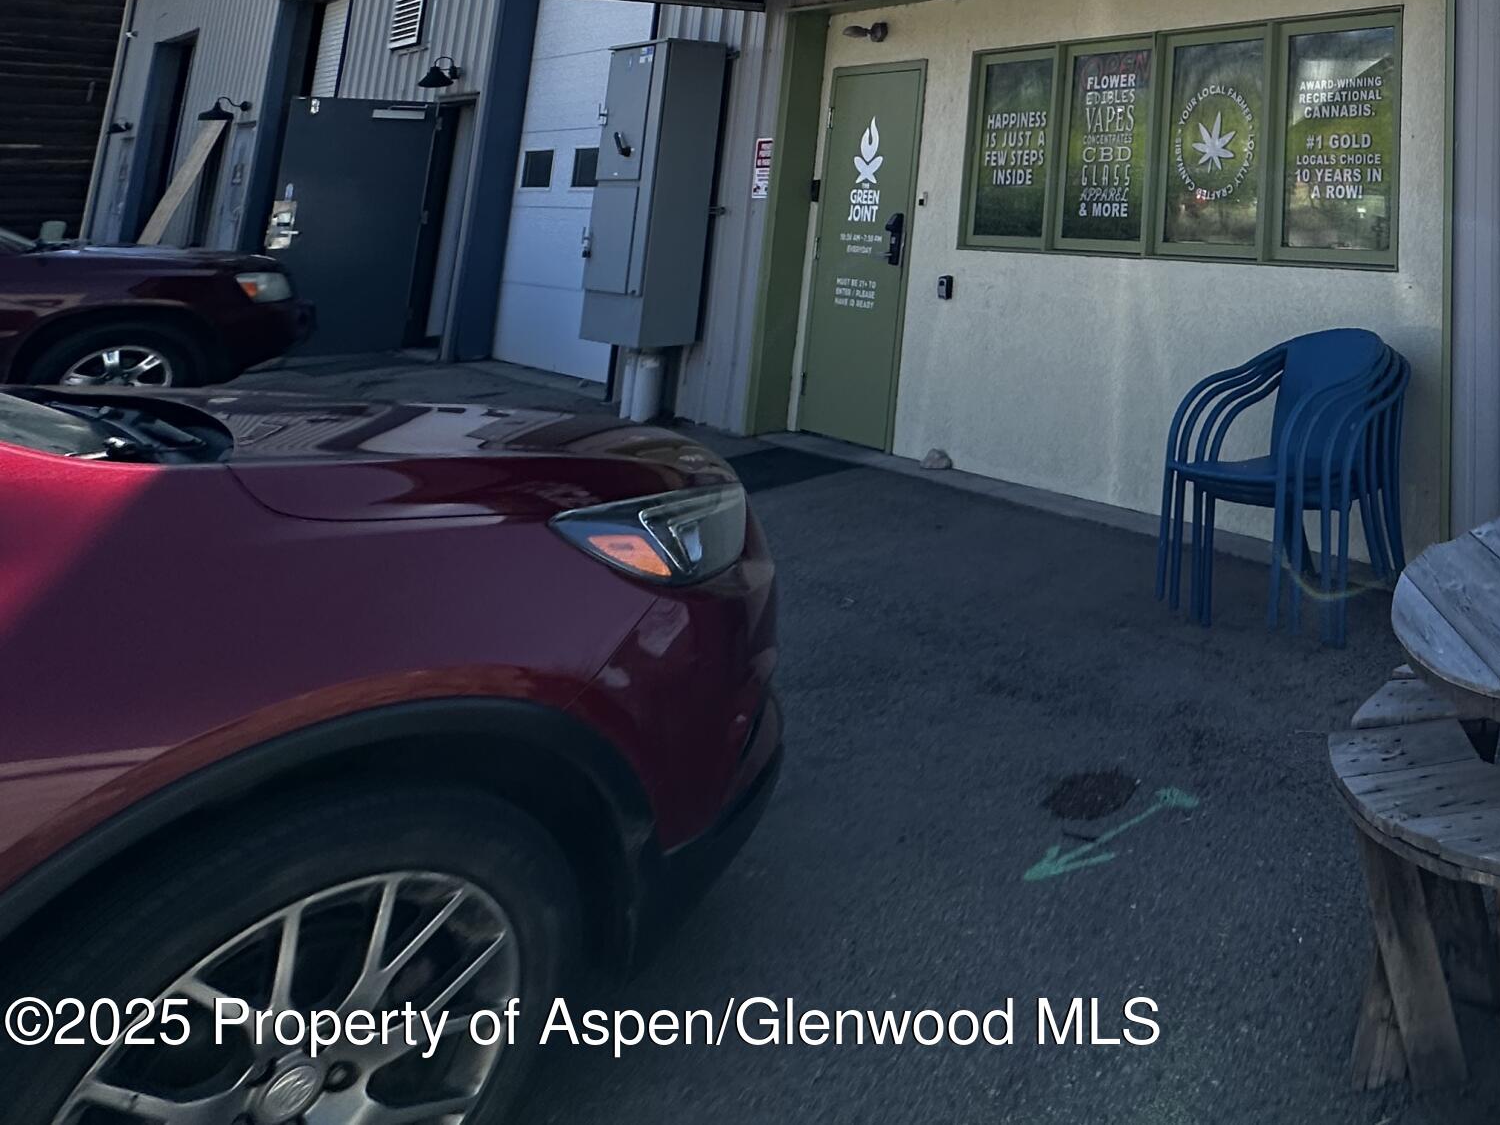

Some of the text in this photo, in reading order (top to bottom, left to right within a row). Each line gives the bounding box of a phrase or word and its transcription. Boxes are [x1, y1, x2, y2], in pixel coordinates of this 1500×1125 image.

[1086, 73, 1136, 90] FLOWER
[1299, 76, 1382, 91] AWARD-WINNING
[1086, 89, 1136, 105] EDIBLES
[1178, 85, 1253, 125] YOUR LOCAL FARMER
[1298, 89, 1382, 104] RECREATIONAL
[1086, 105, 1135, 133] VAPES
[1304, 103, 1376, 119] CANNABIS.
[987, 111, 1047, 129] HAPPINESS
[985, 130, 1045, 148] IS JUST A
[1306, 133, 1372, 150] #1 GOLD
[985, 149, 1044, 166] FEW STEPS
[1082, 146, 1132, 163] CBD
[1234, 134, 1255, 187] LOCALLY
[1296, 153, 1381, 165] LOCALS CHOICE
[992, 168, 1033, 185] INSIDE
[1081, 164, 1131, 186] GLASS
[1295, 168, 1382, 182] 10 YEARS IN
[850, 189, 880, 204] GREEN
[1311, 185, 1363, 199] A ROW!
[847, 205, 879, 223] JOINT
[1078, 202, 1129, 217] & MORE
